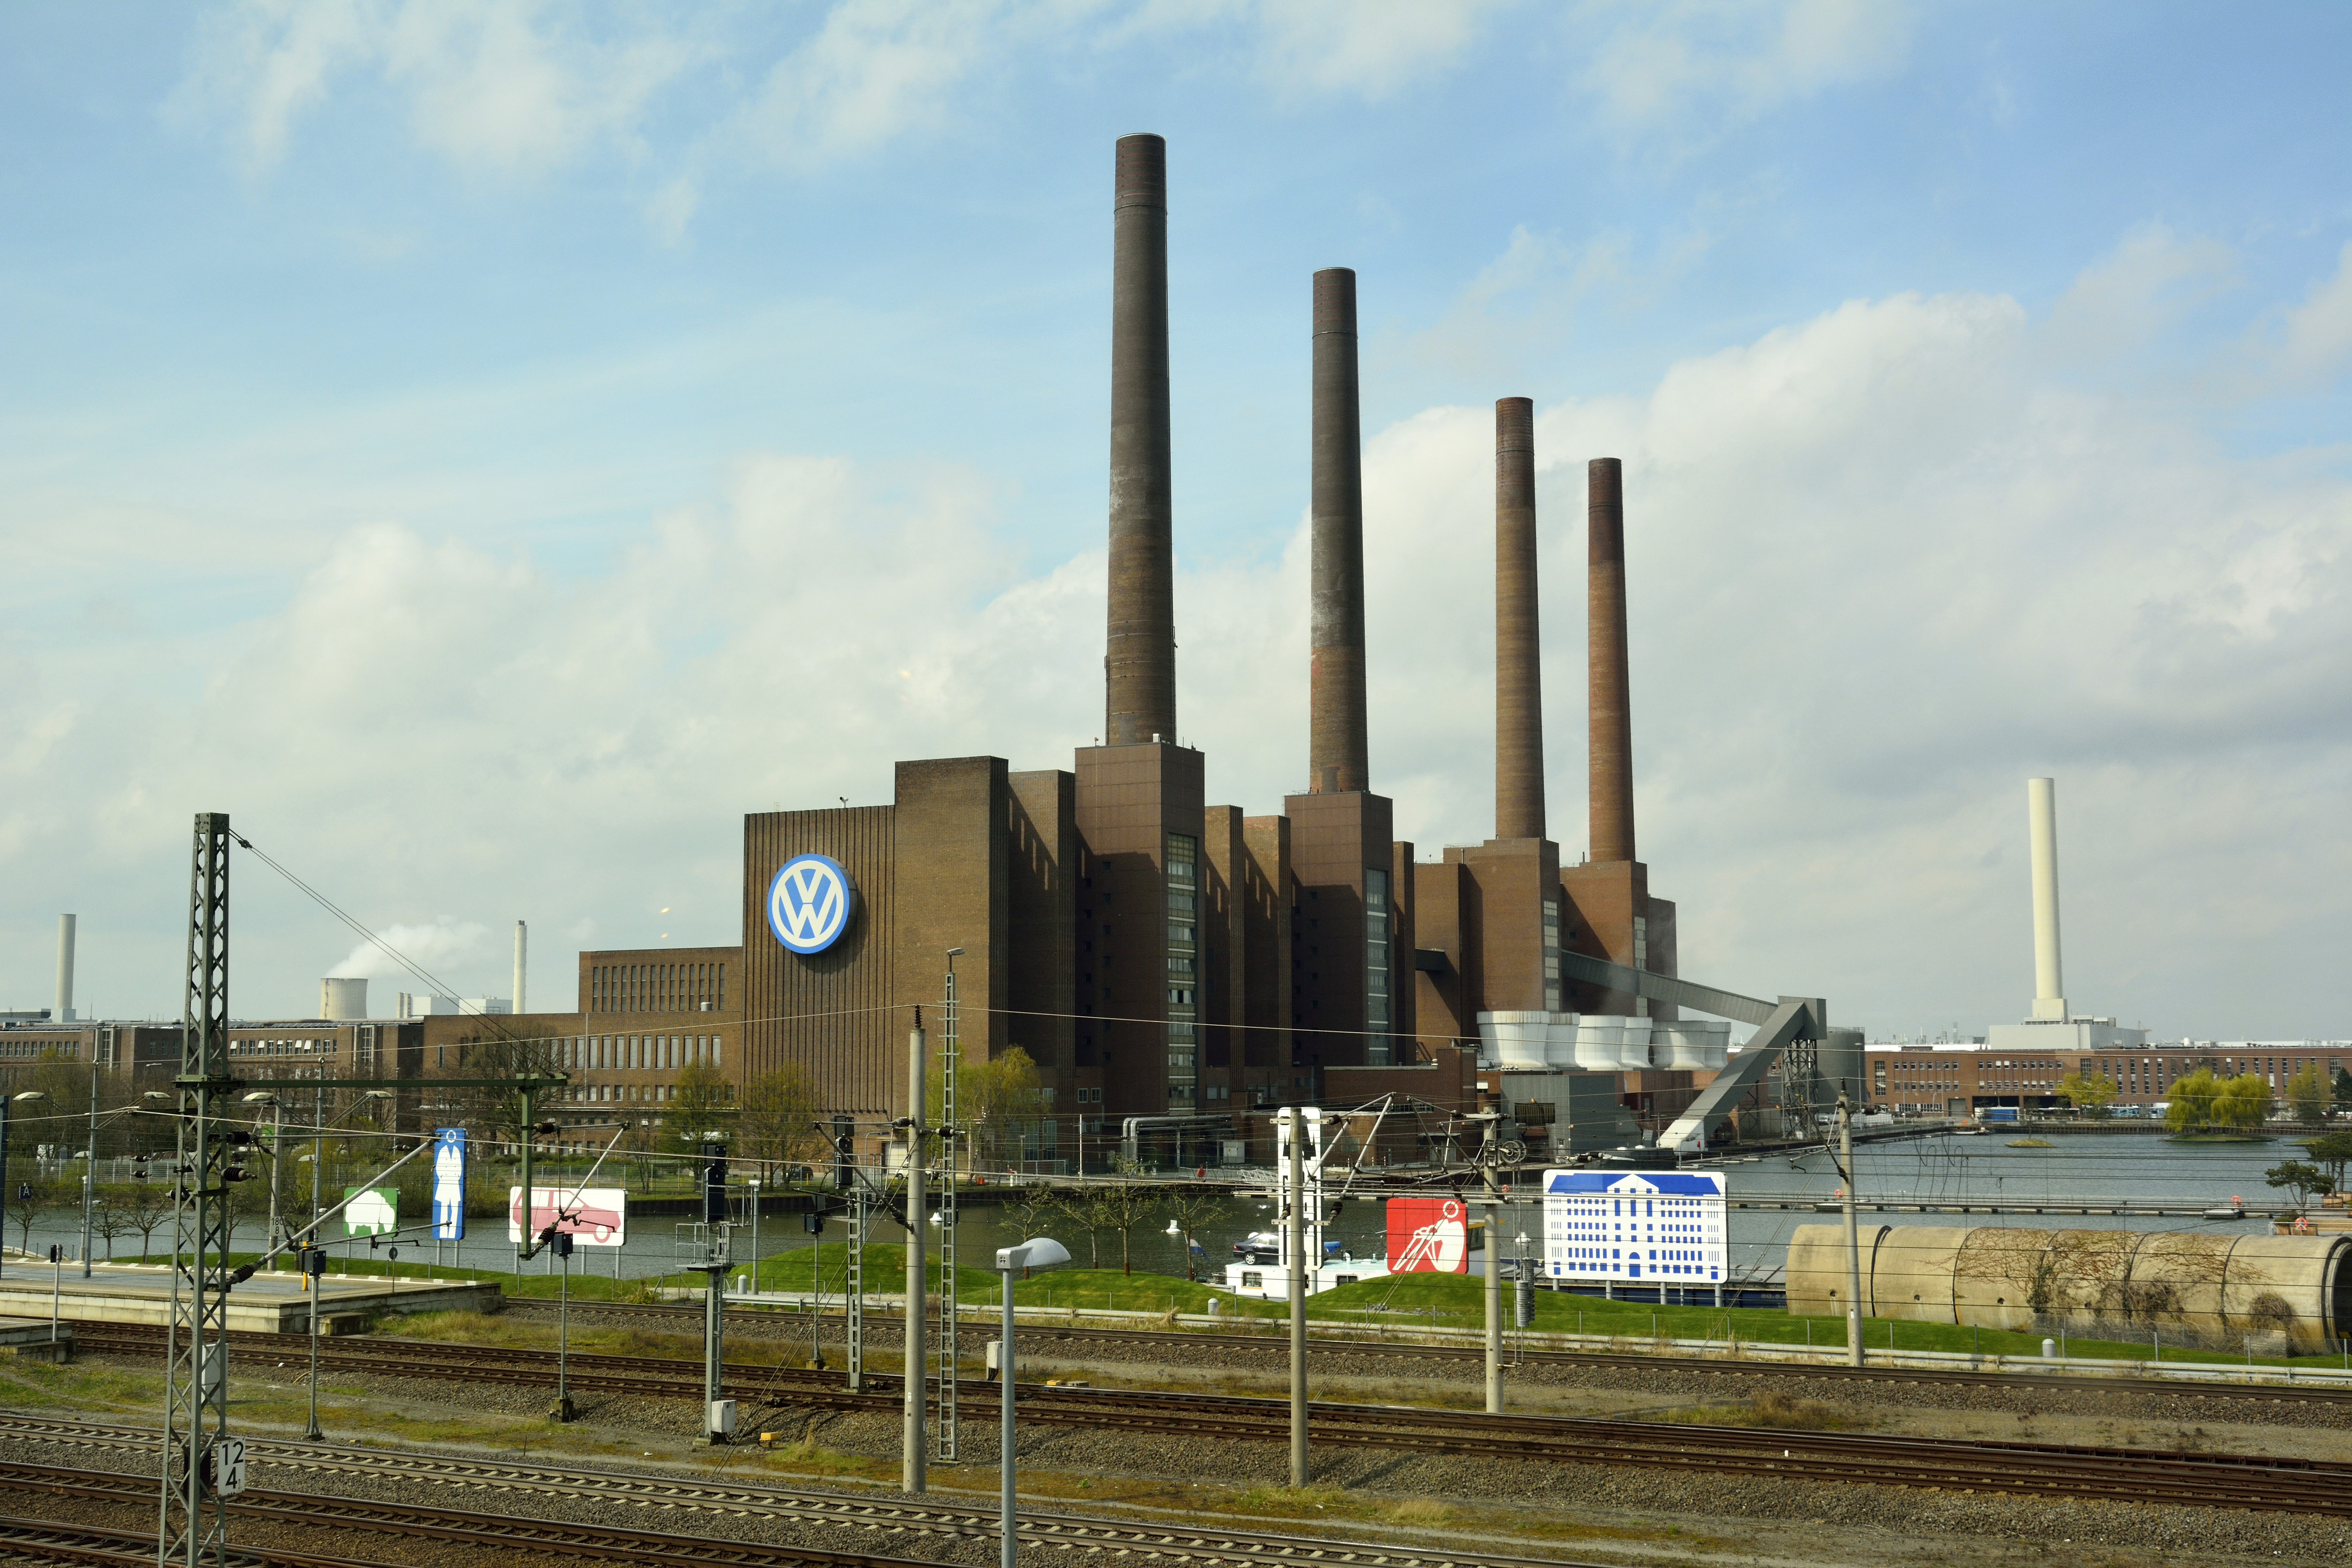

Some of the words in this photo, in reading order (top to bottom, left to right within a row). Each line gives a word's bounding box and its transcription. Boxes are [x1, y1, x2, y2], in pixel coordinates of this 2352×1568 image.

[772, 860, 844, 947] VW
[23, 1186, 30, 1196] A
[222, 1441, 244, 1465] 12
[225, 1466, 238, 1489] 4
